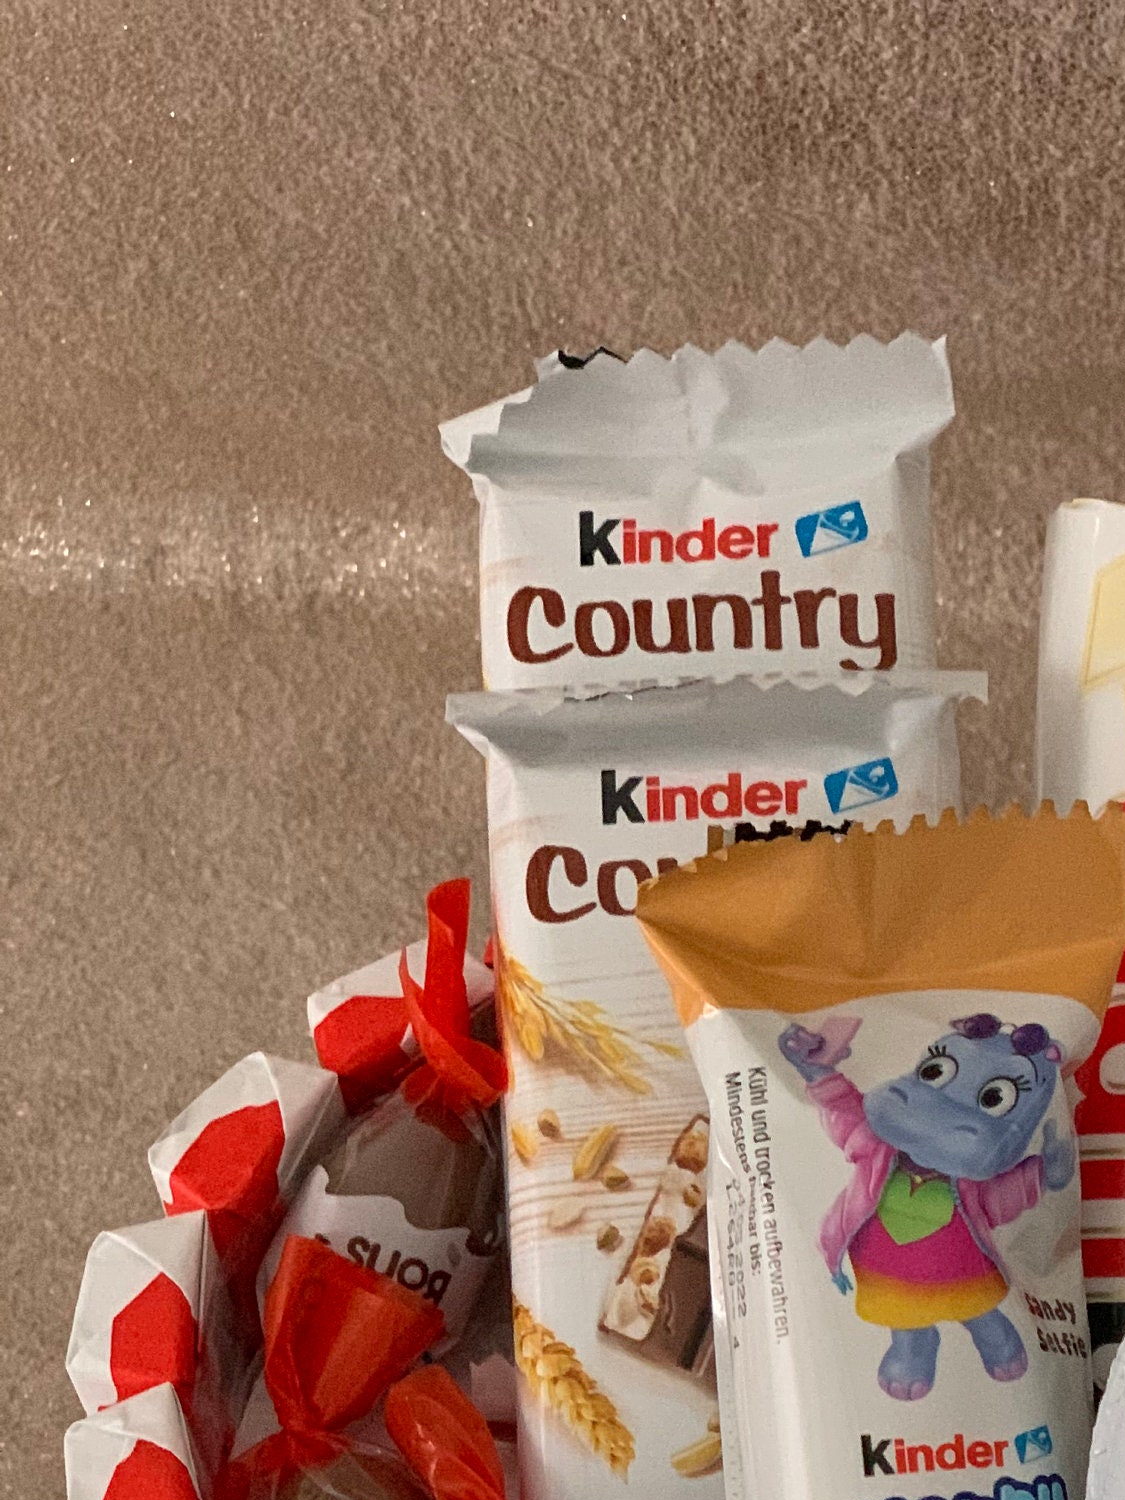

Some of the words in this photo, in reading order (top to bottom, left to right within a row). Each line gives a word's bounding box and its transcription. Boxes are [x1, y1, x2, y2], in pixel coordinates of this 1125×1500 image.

[506, 570, 898, 673] Country
[748, 1066, 769, 1106] Kühl
[725, 1071, 752, 1174] Mindestens
[751, 1109, 772, 1144] und
[755, 1147, 777, 1215] trocken
[764, 1218, 791, 1345] aufbewahren.
[1024, 1291, 1076, 1325] Sandy
[1037, 1326, 1087, 1359] Selfie
